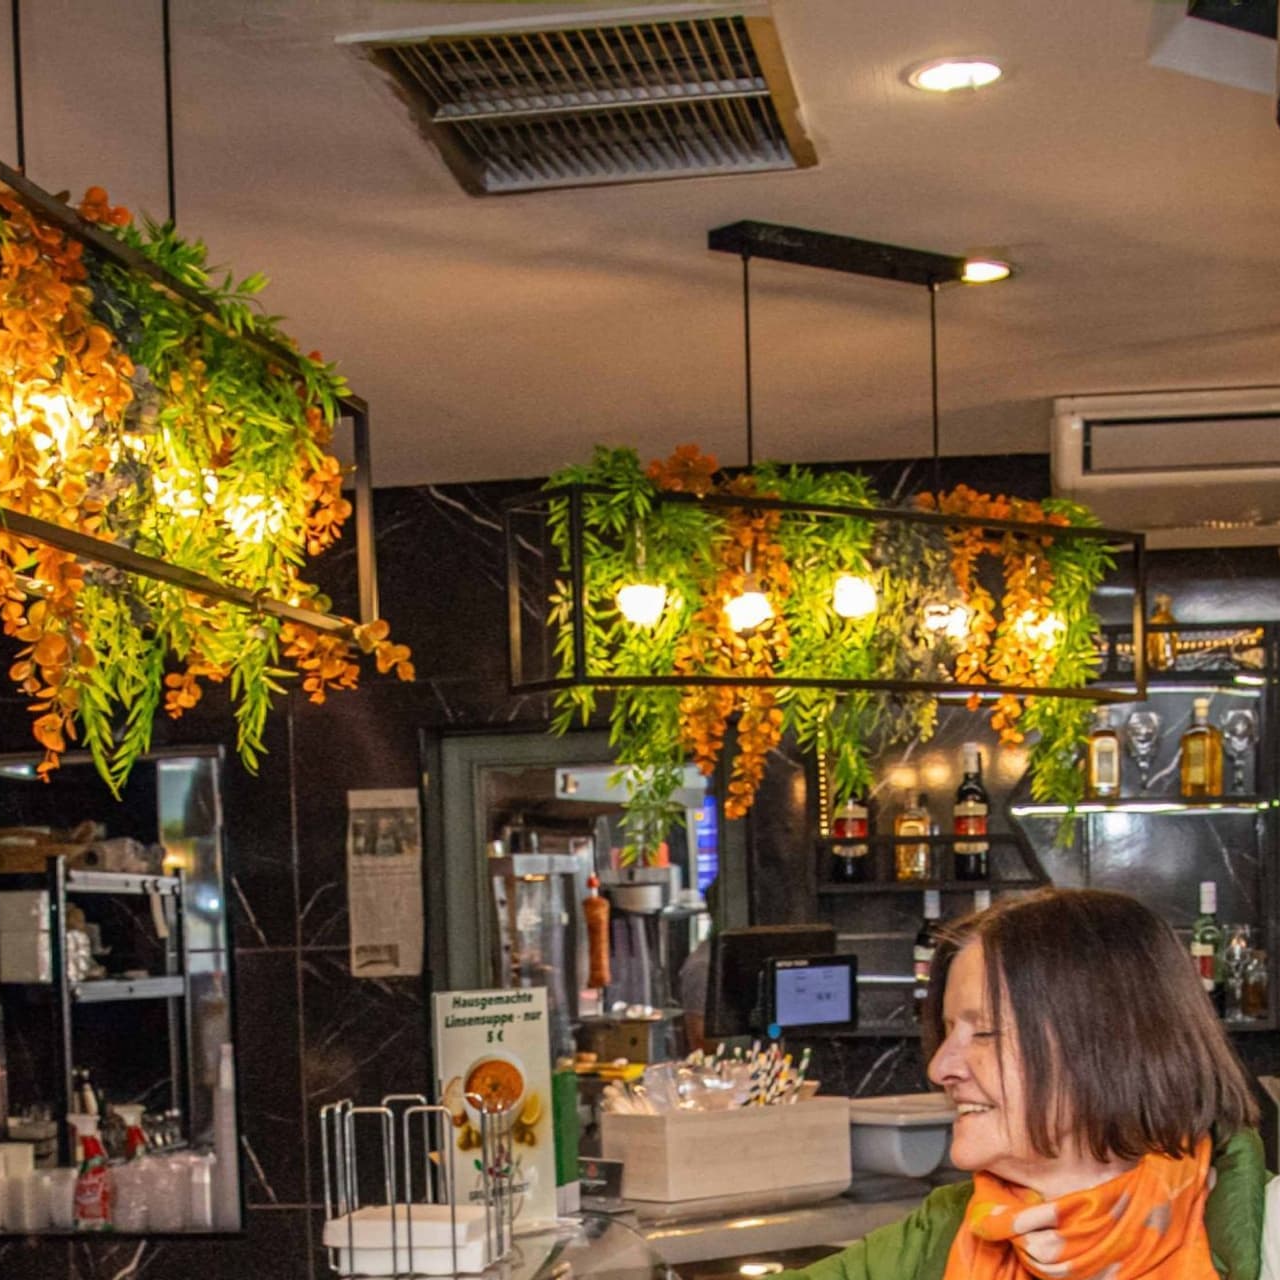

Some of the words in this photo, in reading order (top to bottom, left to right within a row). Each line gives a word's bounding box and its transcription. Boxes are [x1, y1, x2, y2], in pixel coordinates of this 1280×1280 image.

[452, 993, 532, 1010] Hausgemachte
[445, 1012, 514, 1028] Linsensuppe
[523, 1011, 541, 1021] nur
